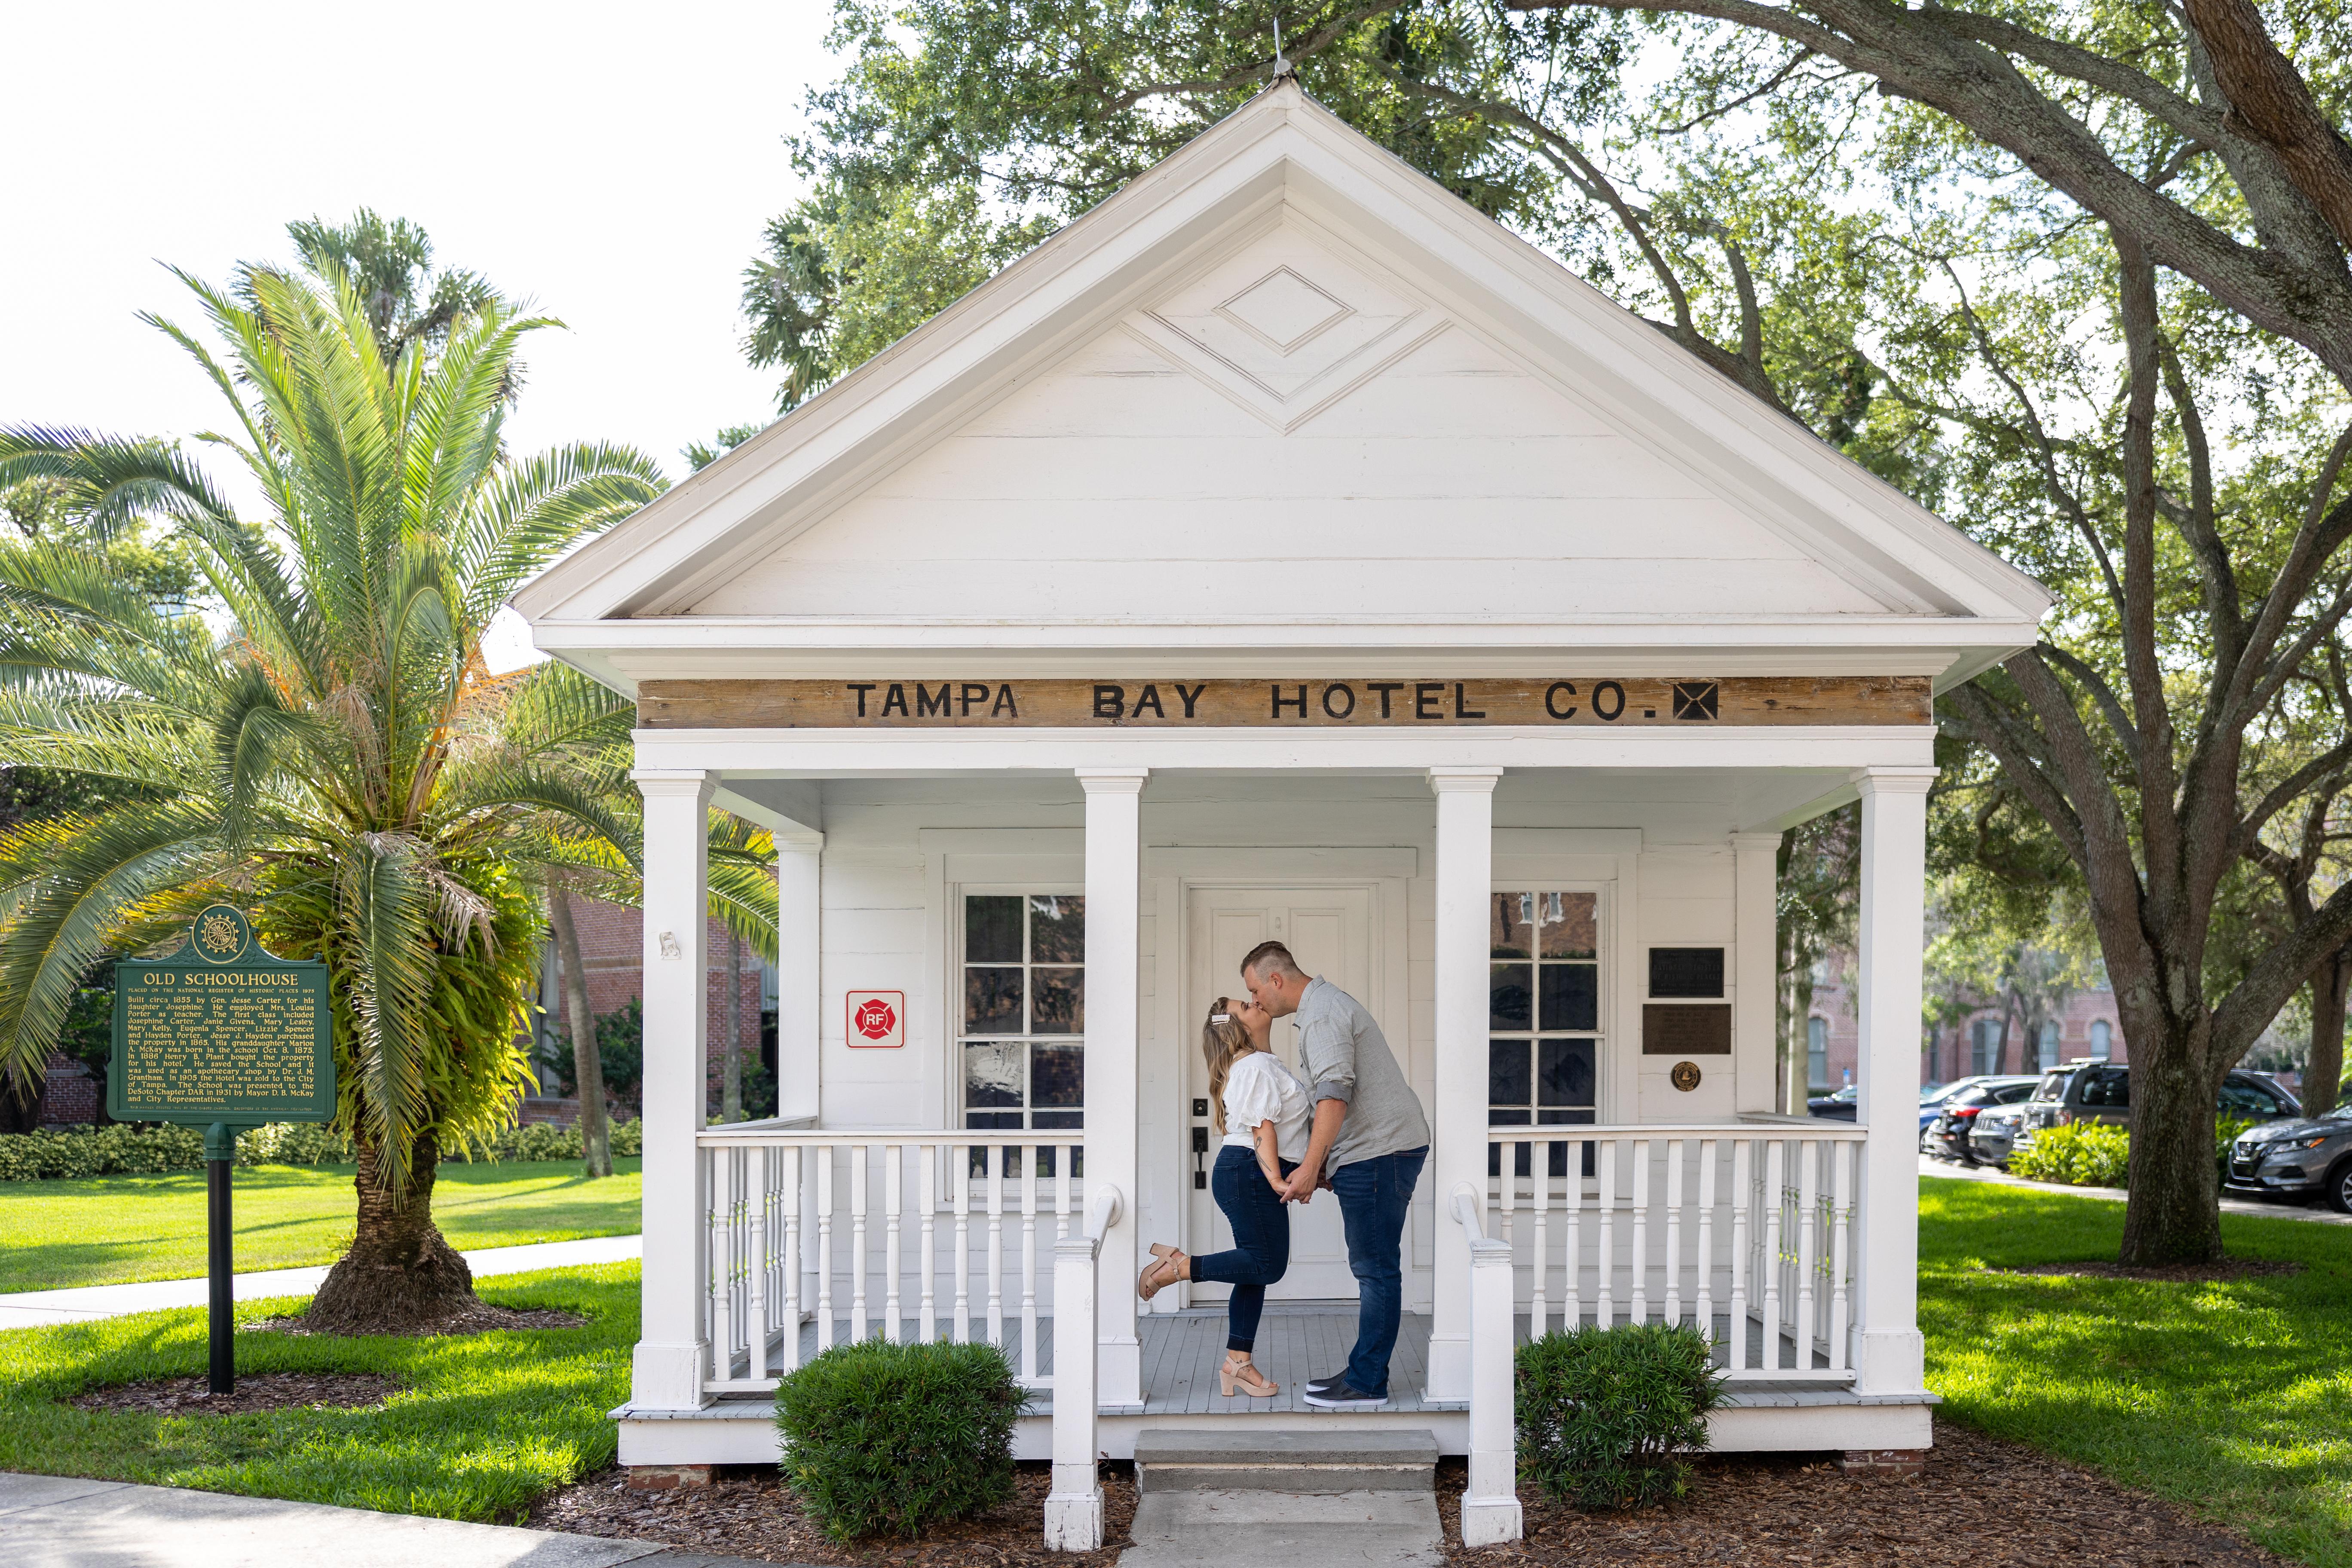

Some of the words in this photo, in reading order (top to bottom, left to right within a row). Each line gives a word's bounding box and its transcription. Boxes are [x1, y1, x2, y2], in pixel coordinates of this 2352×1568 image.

[847, 683, 1018, 717] TAMPA
[1093, 684, 1206, 718] BAY
[1271, 683, 1486, 719] HOTEL
[1545, 680, 1656, 721] CO.
[144, 973, 175, 985] OLD
[185, 974, 298, 985] SCHOOLHOUSE
[866, 1014, 884, 1025] RF
